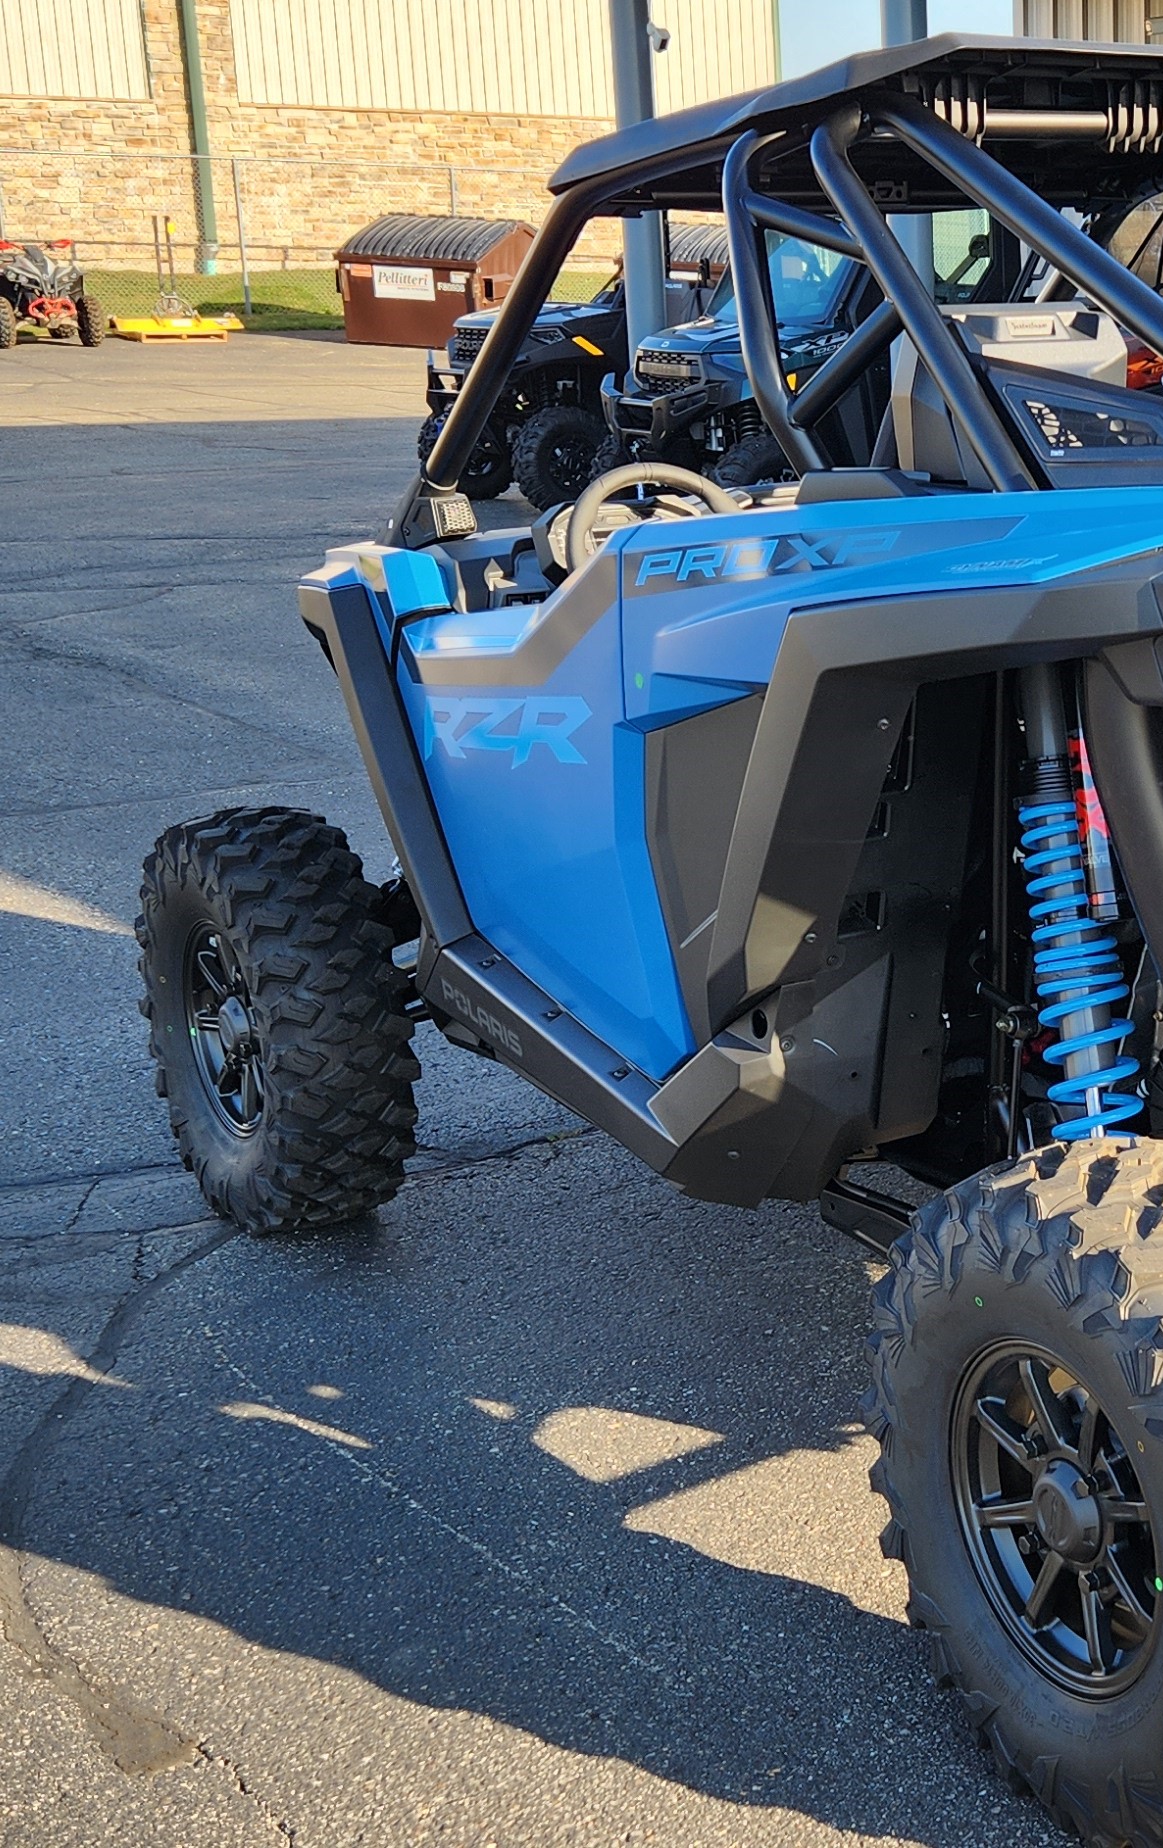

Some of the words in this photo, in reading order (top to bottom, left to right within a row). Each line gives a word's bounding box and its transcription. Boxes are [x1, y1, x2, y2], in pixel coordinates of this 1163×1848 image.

[378, 271, 429, 286] Pellitteri
[634, 538, 779, 587] PRO
[777, 530, 901, 571] XP
[423, 695, 594, 770] RZR
[441, 978, 523, 1058] POLARIS
